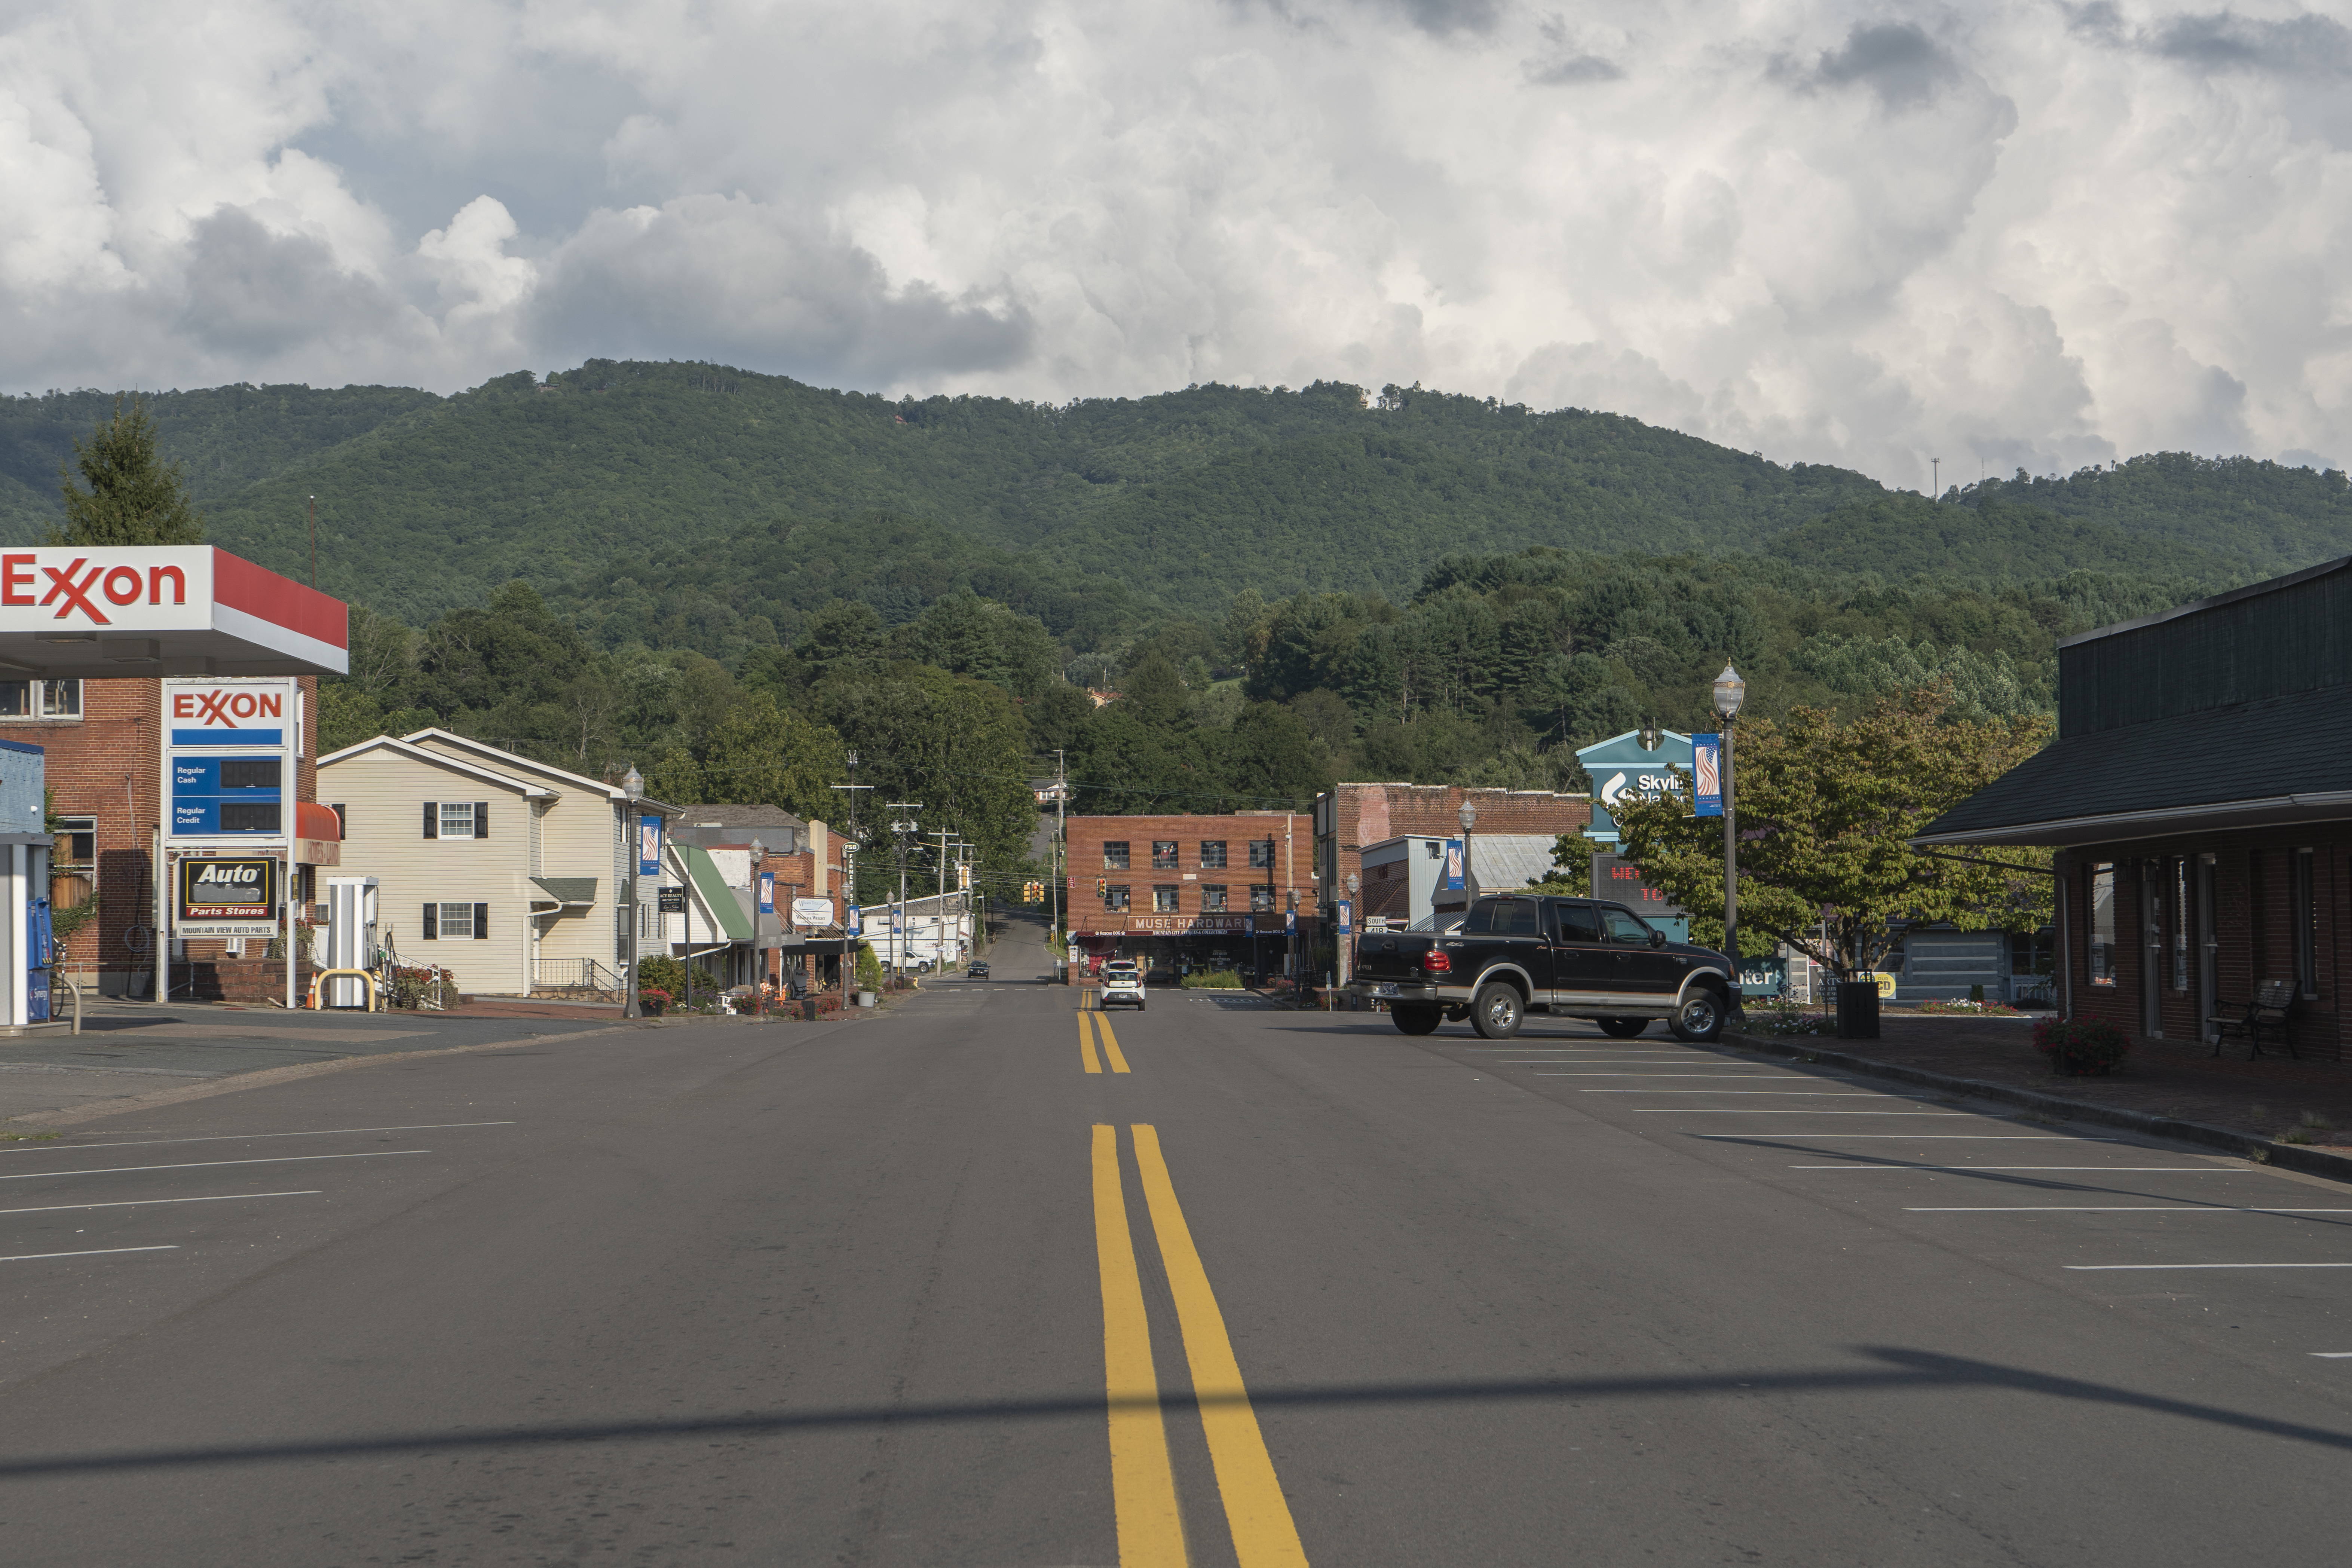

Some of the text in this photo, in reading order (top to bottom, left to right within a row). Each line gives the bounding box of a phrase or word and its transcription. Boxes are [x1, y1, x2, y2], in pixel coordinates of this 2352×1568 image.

[173, 689, 282, 728] EXXON
[197, 864, 258, 882] Auto
[1641, 889, 1663, 900] TO
[1136, 919, 1172, 928] MUSE
[1877, 981, 1890, 990] CD
